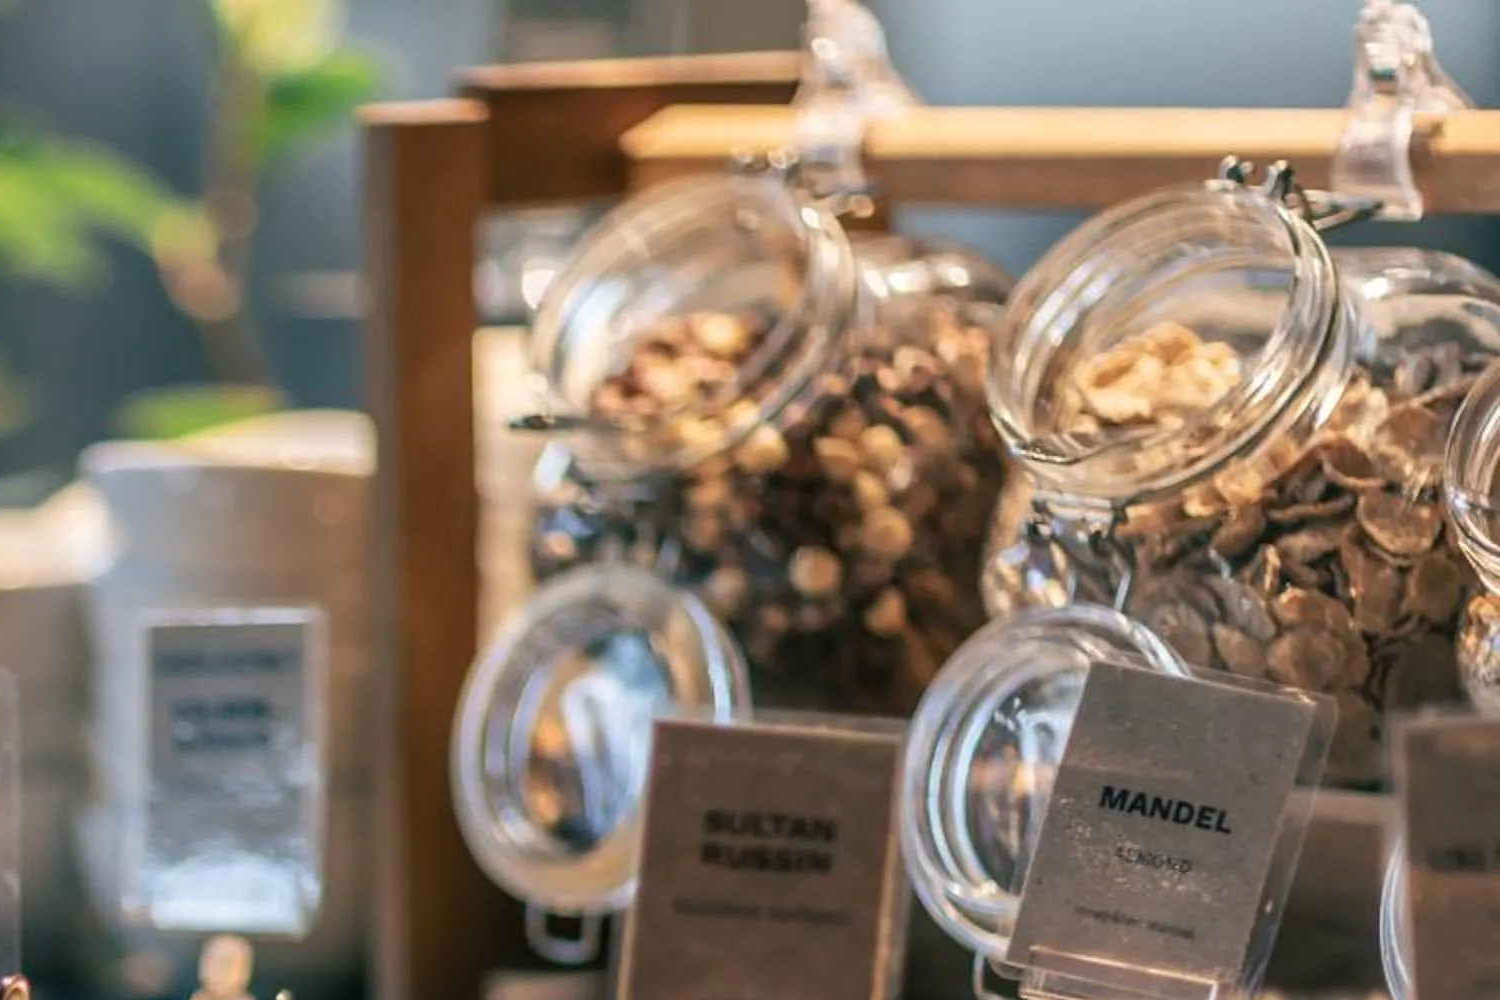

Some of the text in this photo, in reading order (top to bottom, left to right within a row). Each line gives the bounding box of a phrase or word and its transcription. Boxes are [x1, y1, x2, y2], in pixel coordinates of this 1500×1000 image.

[704, 809, 838, 843] SULTAN
[1099, 785, 1232, 834] MANDEL
[701, 840, 833, 875] RUSSIN
